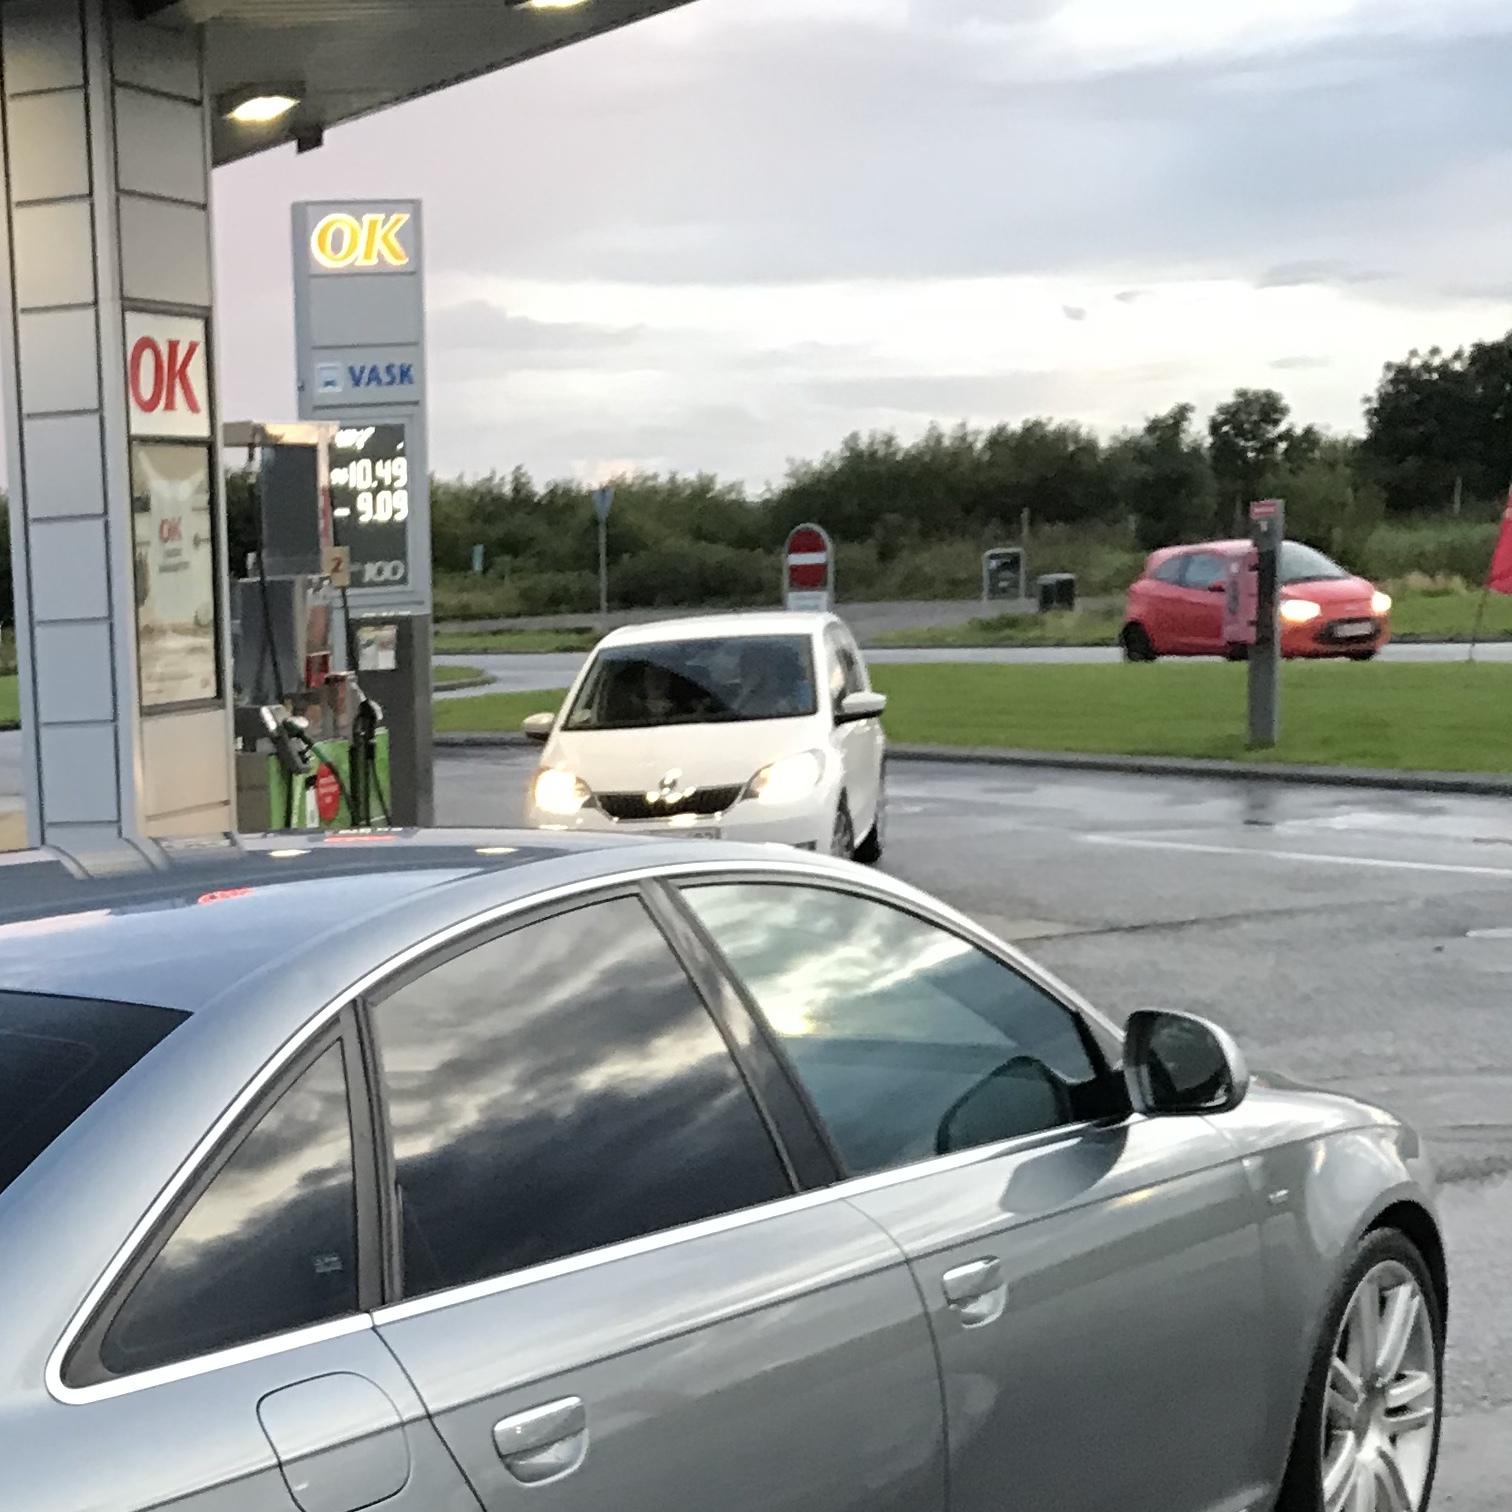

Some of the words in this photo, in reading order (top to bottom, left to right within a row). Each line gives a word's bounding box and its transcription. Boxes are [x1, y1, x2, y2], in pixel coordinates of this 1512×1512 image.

[311, 213, 410, 268] OK
[130, 336, 201, 414] OK
[348, 363, 414, 387] VASK
[159, 516, 182, 543] OK
[331, 557, 343, 573] 2
